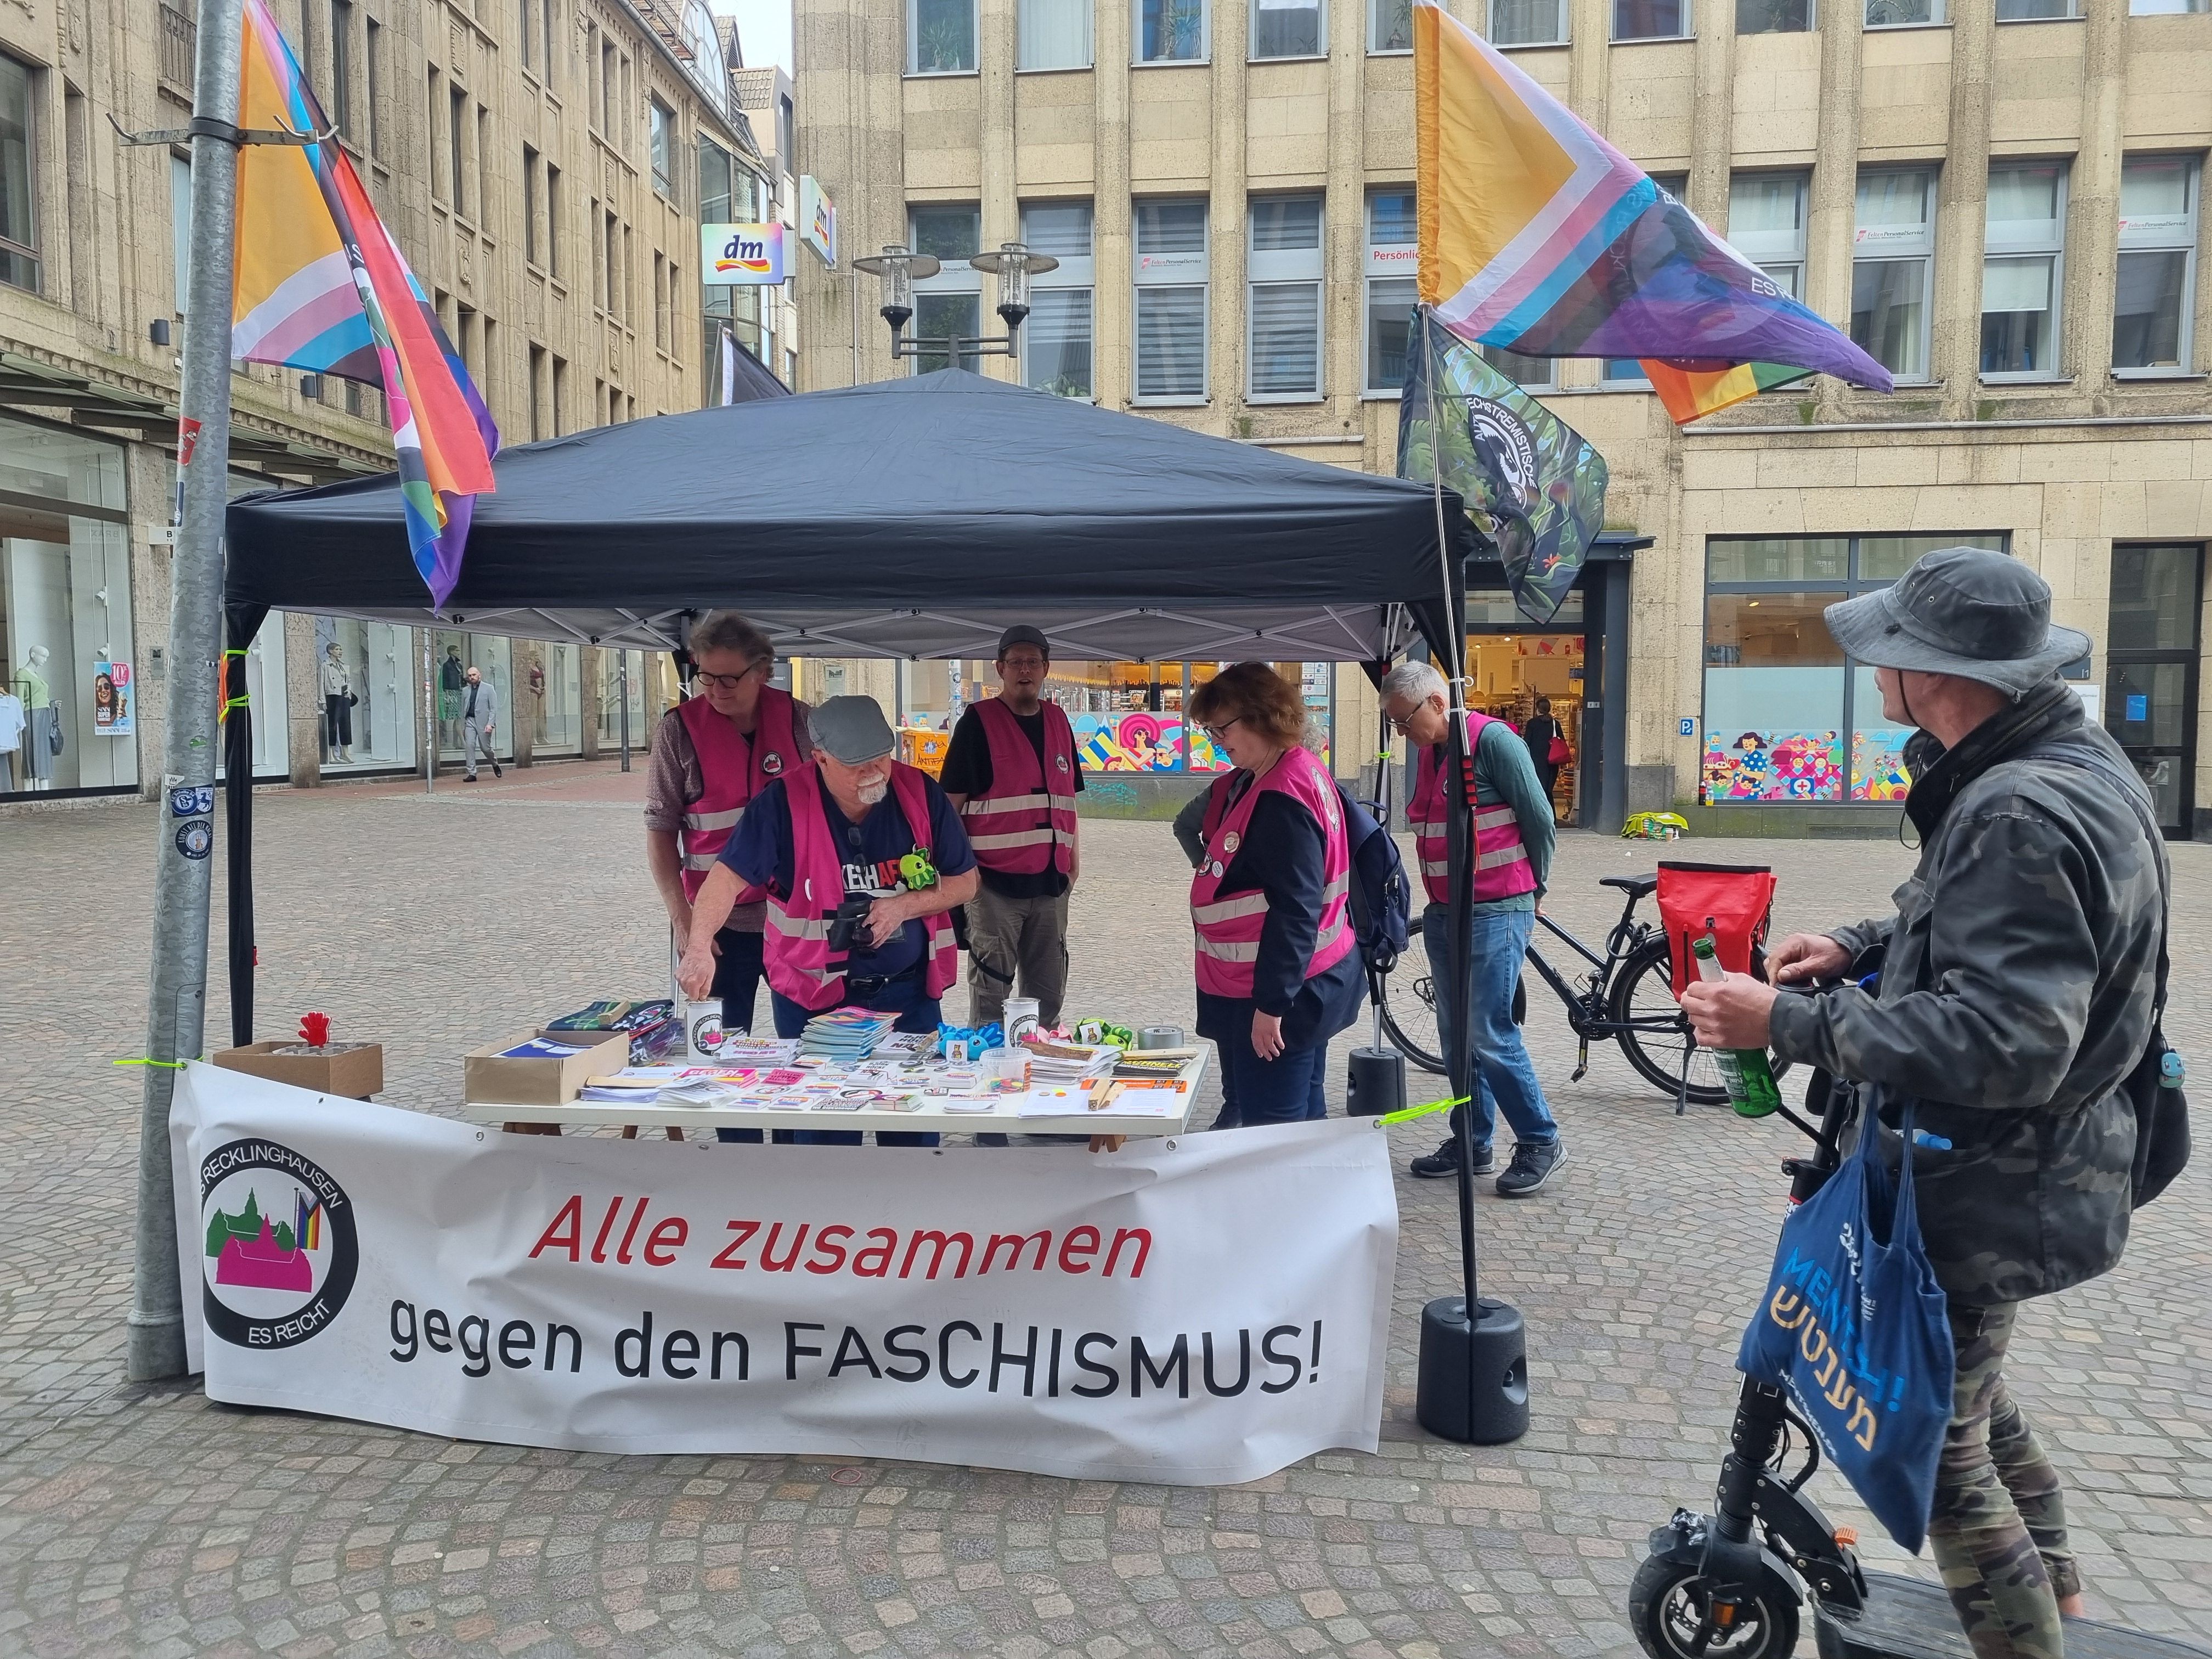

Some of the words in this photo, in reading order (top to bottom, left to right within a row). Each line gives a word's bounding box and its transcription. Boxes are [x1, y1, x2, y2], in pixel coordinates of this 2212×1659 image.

[816, 197, 827, 231] dm
[724, 235, 763, 258] dm
[1752, 276, 1776, 296] ES
[203, 1144, 343, 1209] RECKLINGHAUSEN
[530, 1195, 687, 1266] Alle
[711, 1220, 1151, 1279] zusammen
[249, 1327, 272, 1344] ES
[275, 1298, 330, 1342] REICHT
[390, 1299, 582, 1378] gegen
[615, 1311, 749, 1381] den
[784, 1319, 1322, 1399] FASCHISMUS!
[1770, 1285, 1877, 1452] מענטש
